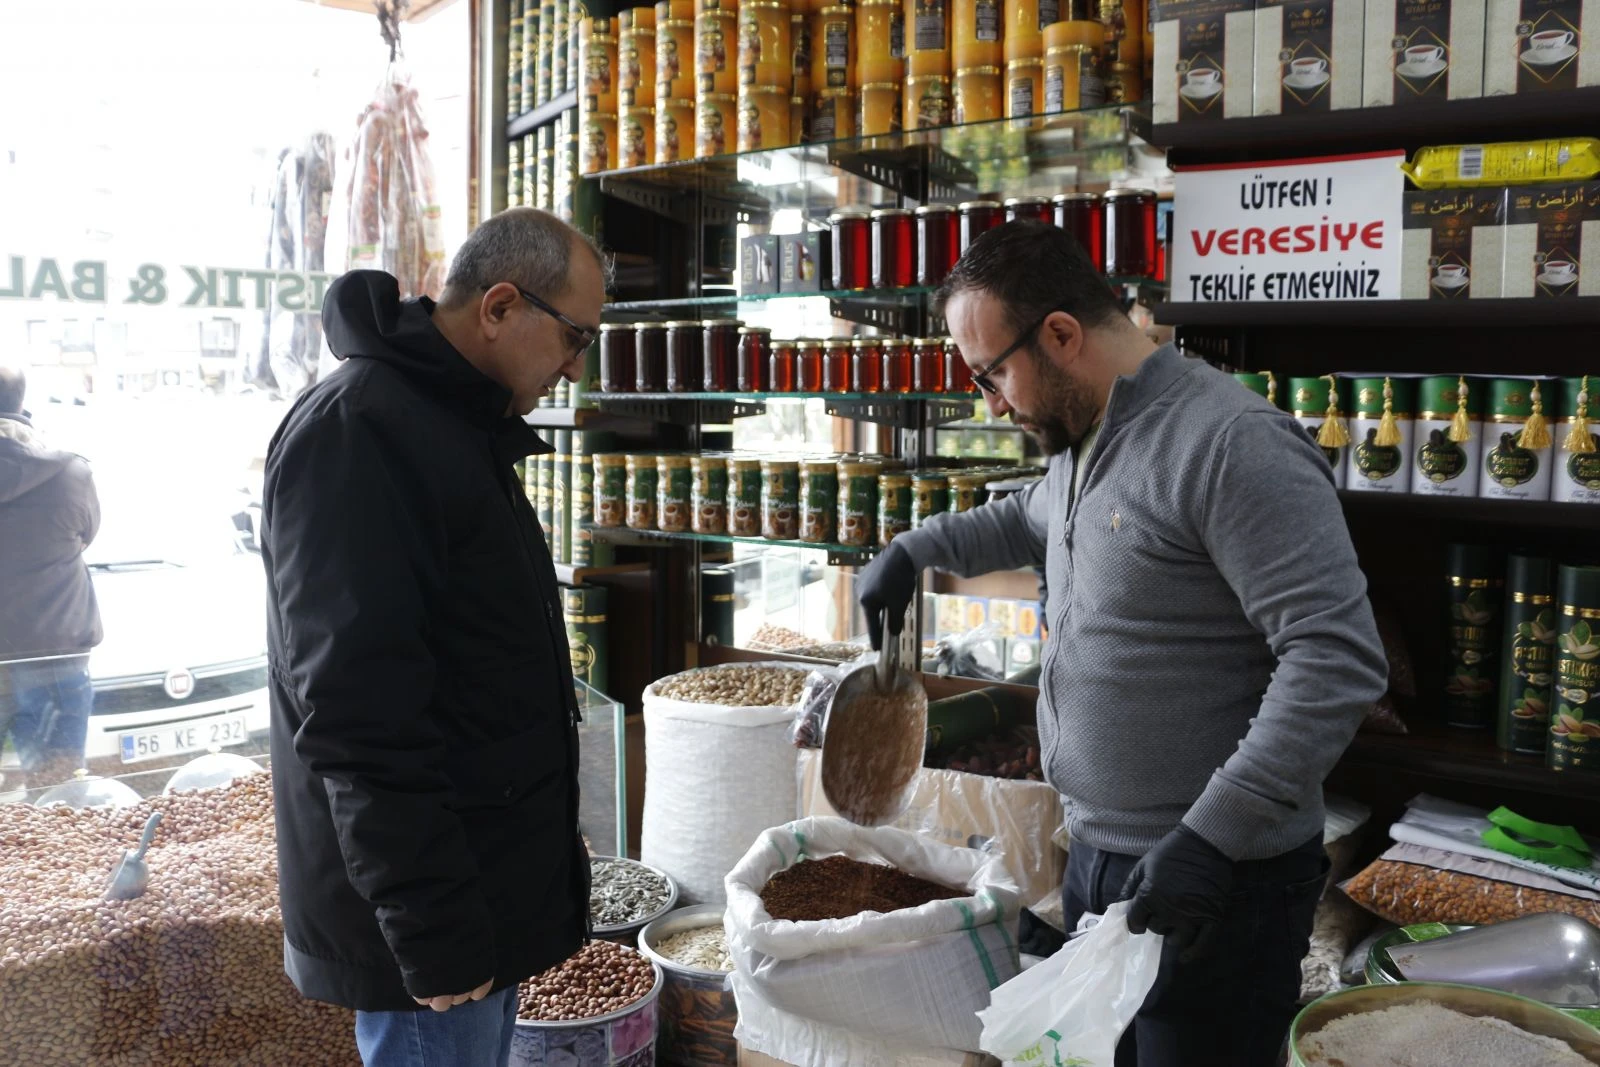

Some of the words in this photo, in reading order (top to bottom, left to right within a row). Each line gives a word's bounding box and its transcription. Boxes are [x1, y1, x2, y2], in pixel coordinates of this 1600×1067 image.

[1241, 174, 1317, 210] LÜTFEN
[1326, 178, 1333, 206] !
[1190, 216, 1385, 257] VERESİYE
[1190, 266, 1256, 301] TEKLİF
[1263, 261, 1381, 300] ETMEYİNİZ
[137, 734, 159, 755] 56
[175, 728, 197, 749] KE
[210, 721, 241, 743] 232
